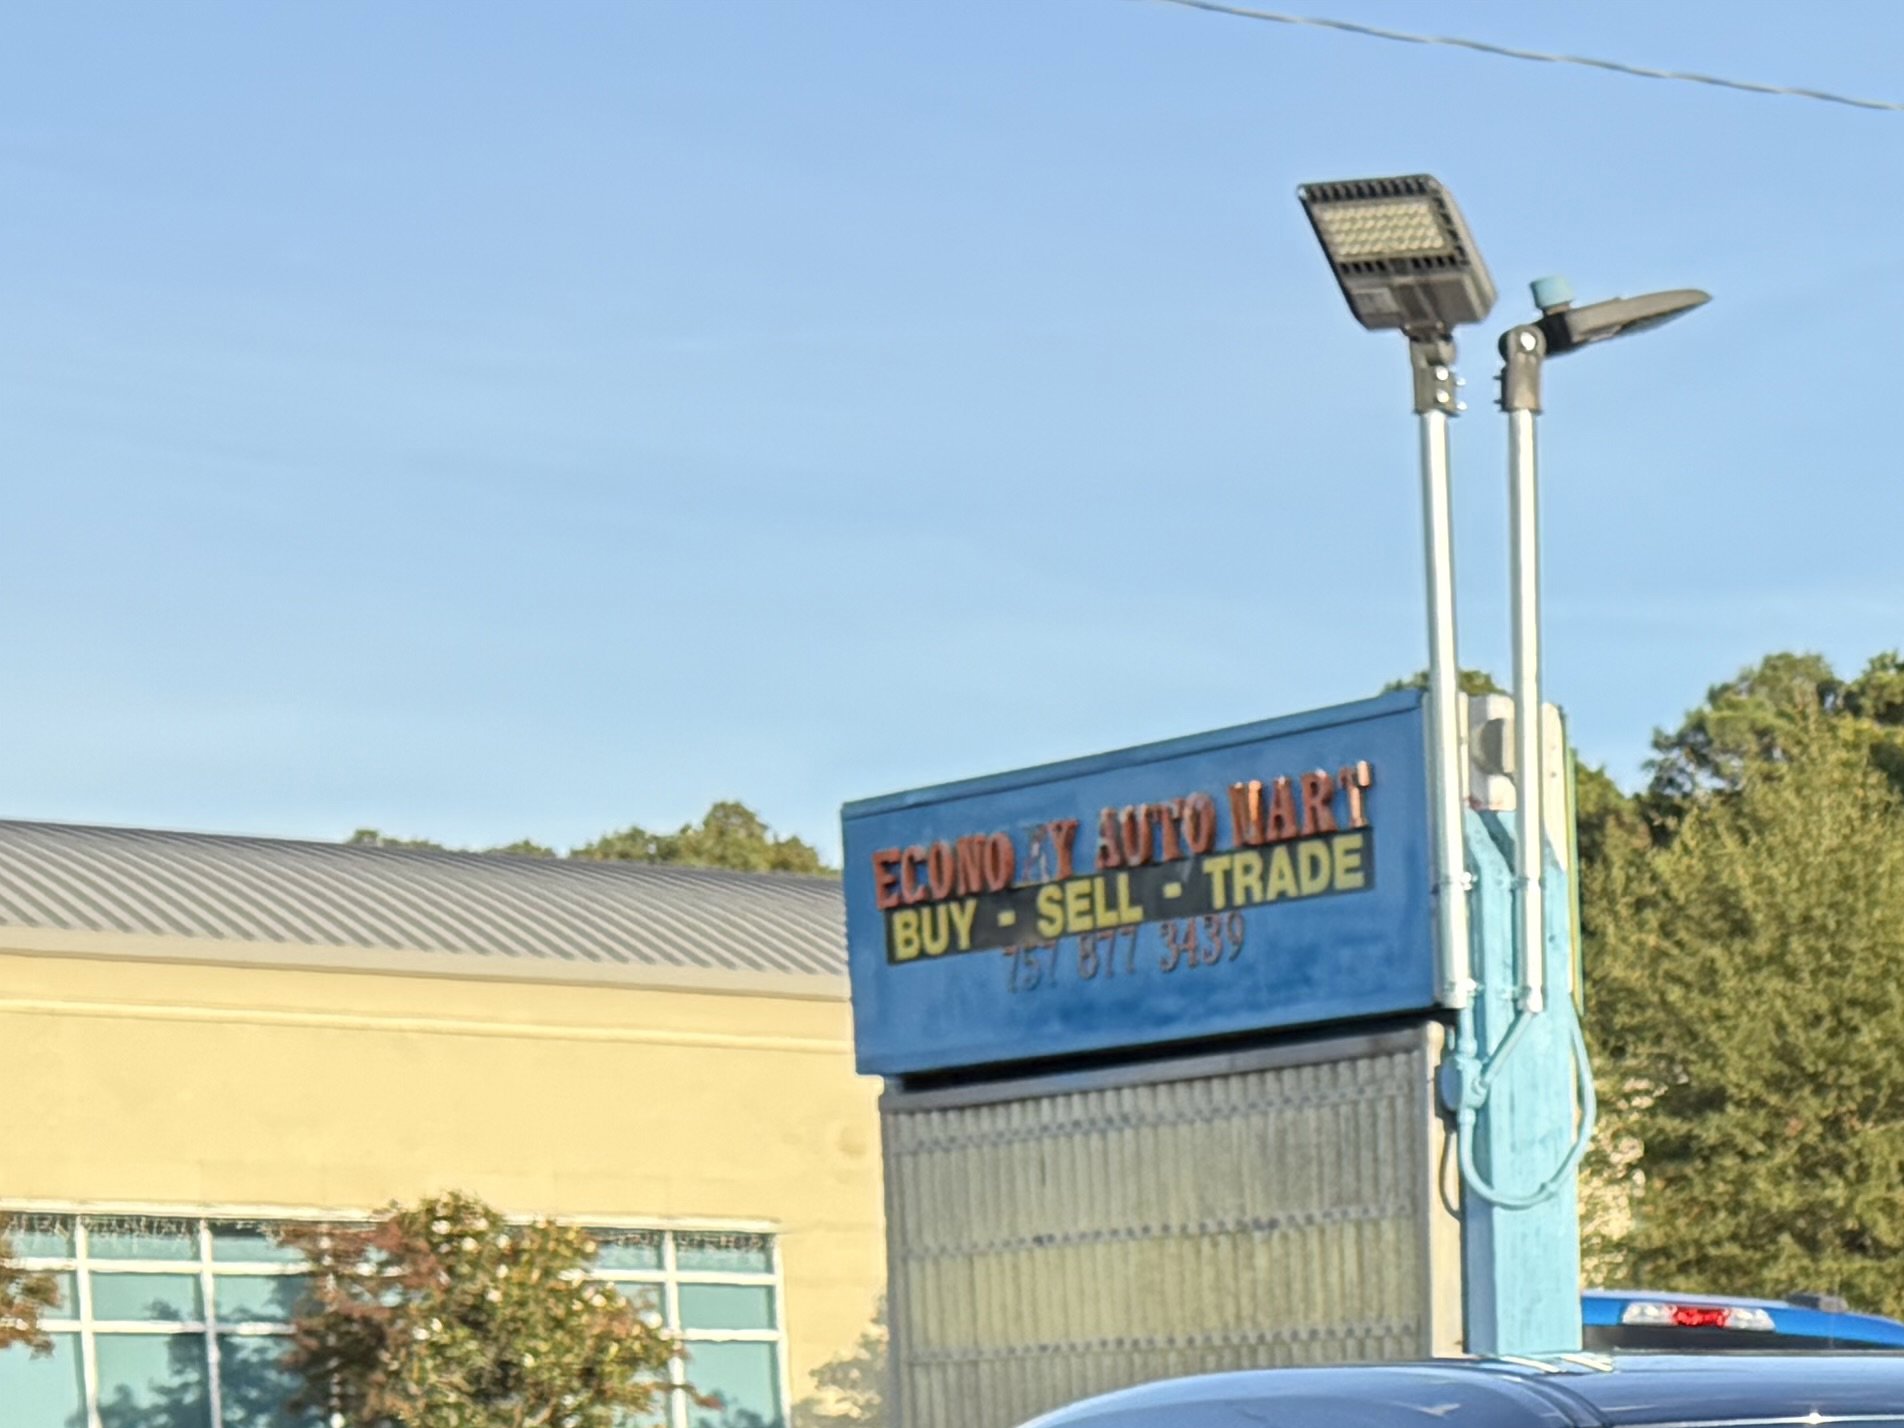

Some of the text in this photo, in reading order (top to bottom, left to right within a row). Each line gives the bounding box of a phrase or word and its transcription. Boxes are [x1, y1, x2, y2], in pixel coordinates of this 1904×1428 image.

[872, 760, 1373, 910] ECONOY AUTO MART
[893, 900, 977, 961] BUY
[1036, 872, 1144, 939] SELL
[1202, 833, 1365, 911] TRADE
[1076, 923, 1138, 981] 877
[1160, 911, 1245, 973] 3439
